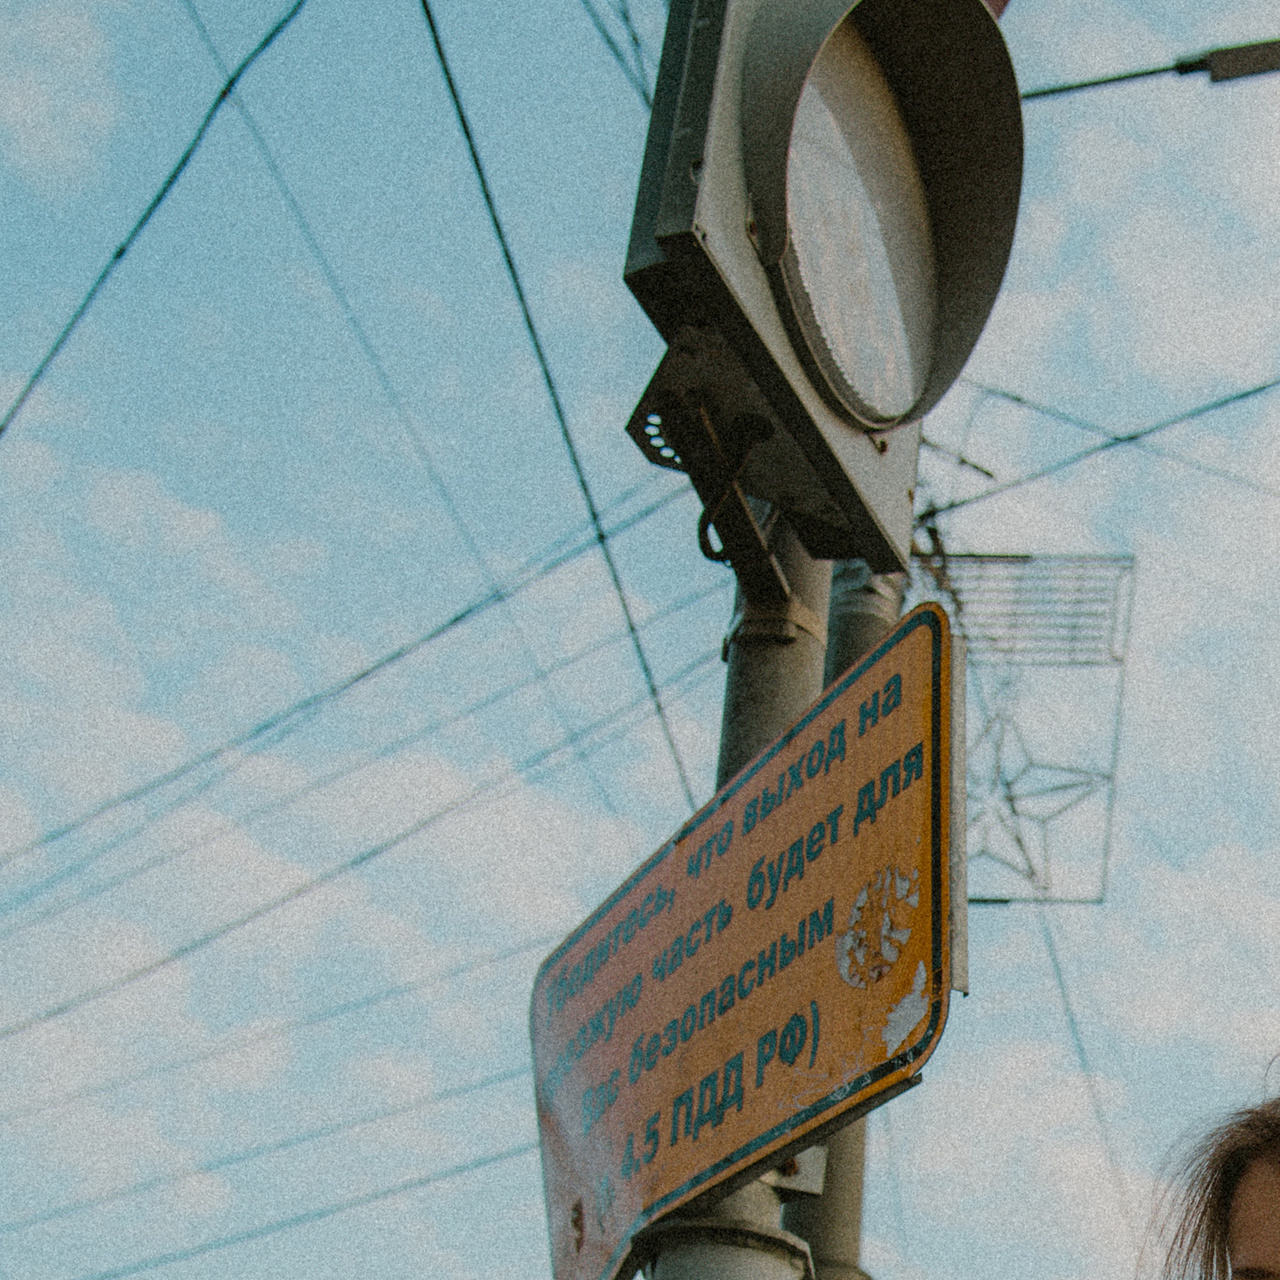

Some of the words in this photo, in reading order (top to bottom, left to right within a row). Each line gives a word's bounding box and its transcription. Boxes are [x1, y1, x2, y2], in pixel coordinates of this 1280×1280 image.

[652, 898, 734, 983] часть
[746, 804, 844, 911] будет
[853, 741, 924, 837] для
[687, 819, 734, 879] что
[742, 719, 847, 837] выход
[858, 673, 902, 738] на
[628, 897, 835, 1086] безопасным
[670, 1051, 744, 1147] ПДД
[756, 1000, 820, 1089] РФ)
